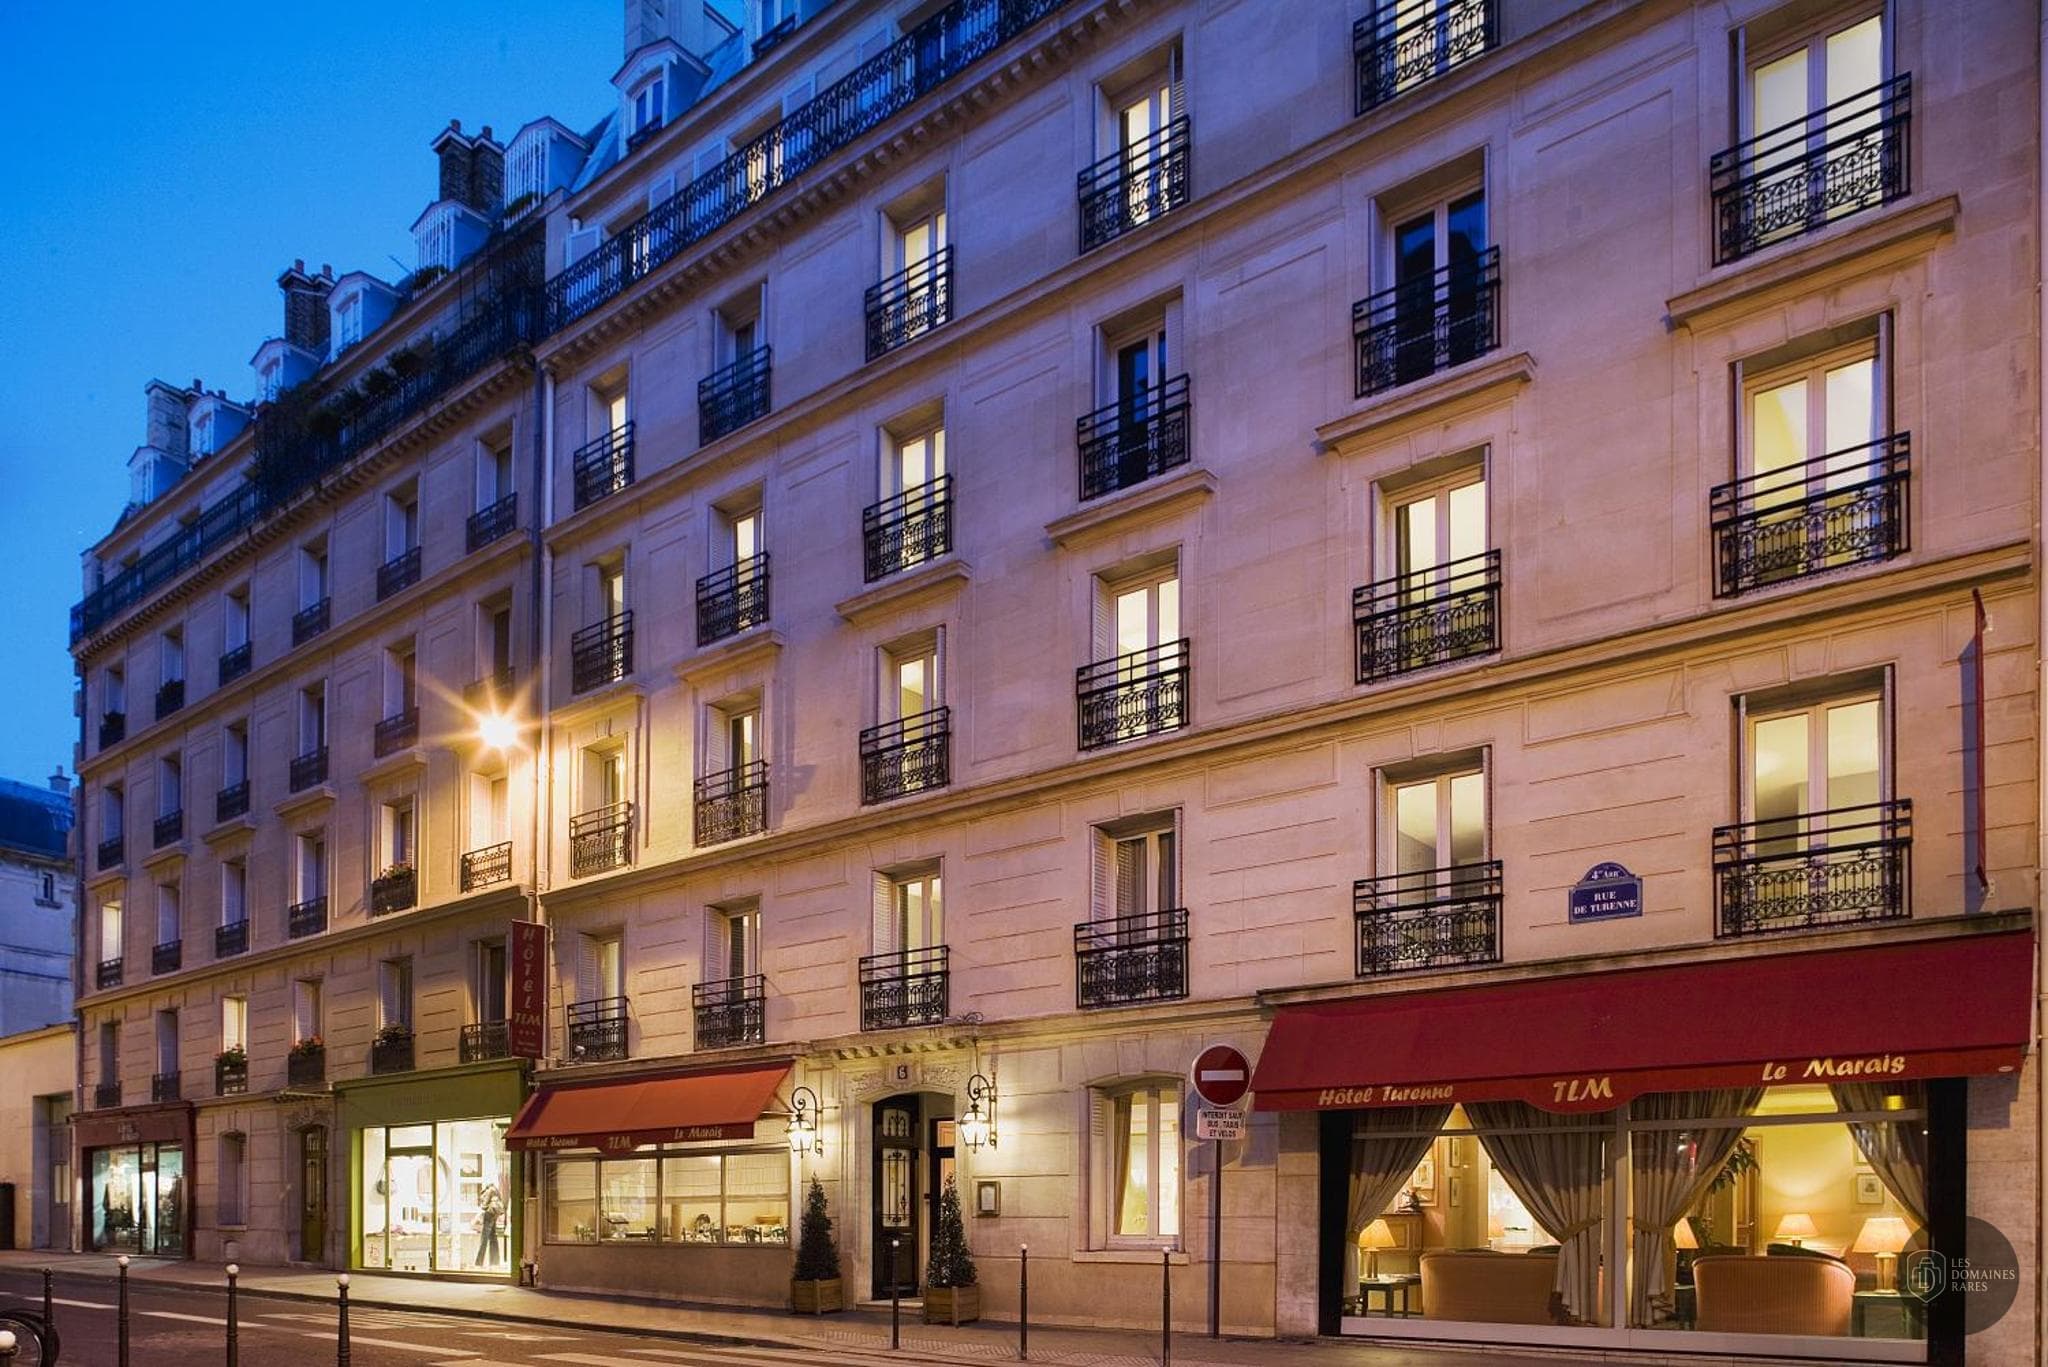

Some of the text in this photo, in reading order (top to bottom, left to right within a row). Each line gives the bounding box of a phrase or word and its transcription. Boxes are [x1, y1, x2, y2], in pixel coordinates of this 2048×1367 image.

[1594, 891, 1617, 902] RUE
[1574, 899, 1637, 915] DE TURENNE
[1762, 1055, 1906, 1081] Le Marais
[1318, 1084, 1454, 1106] Hôtel Turenne
[1553, 1077, 1614, 1103] TLM
[674, 1126, 723, 1140] Le Marais
[608, 1136, 632, 1150] TLM
